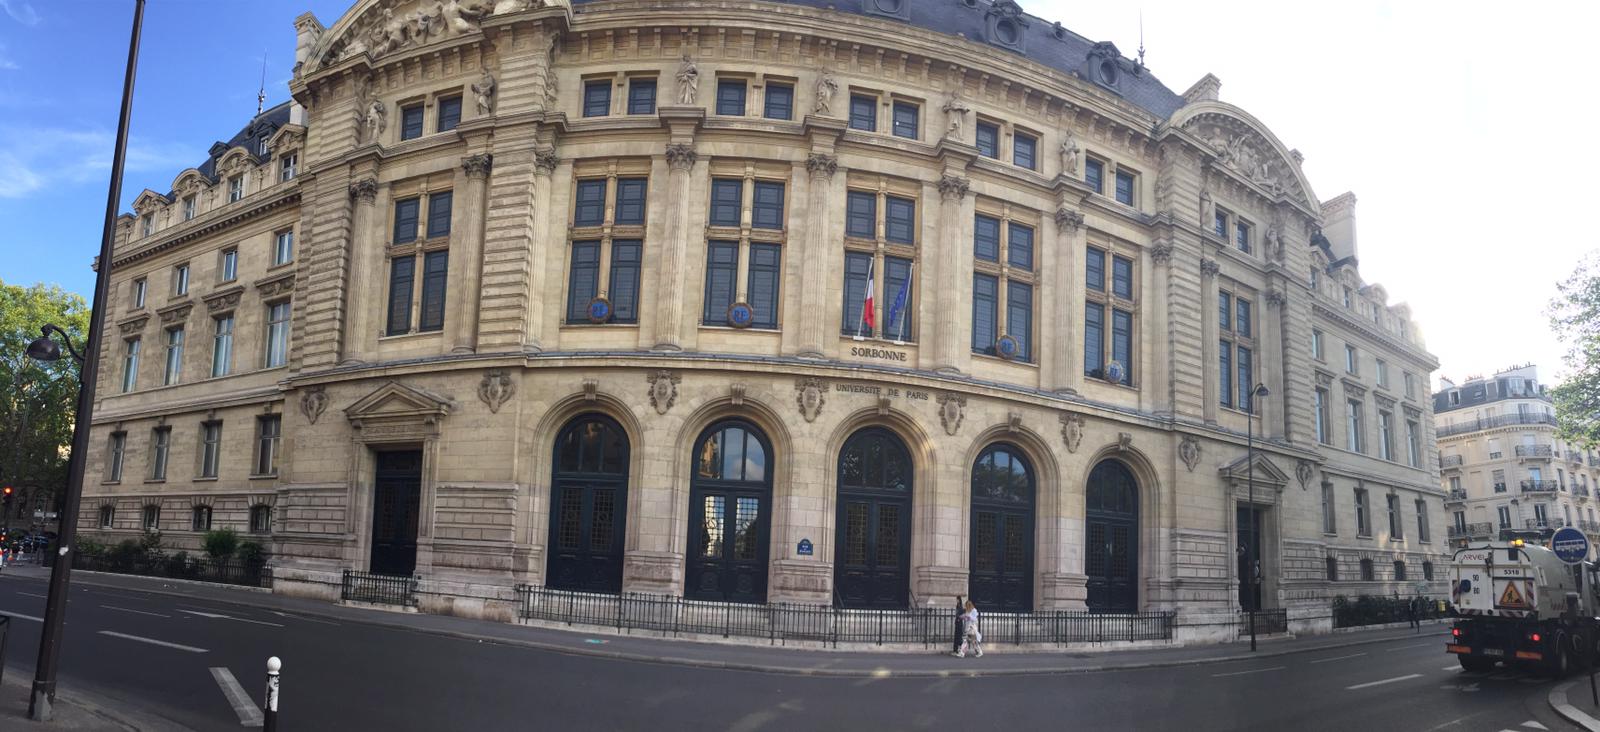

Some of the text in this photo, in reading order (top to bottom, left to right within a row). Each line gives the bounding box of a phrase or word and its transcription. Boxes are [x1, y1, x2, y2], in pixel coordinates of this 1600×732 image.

[851, 347, 907, 361] SORBONNE
[836, 384, 929, 400] UNIVERSITE DE PARIS
